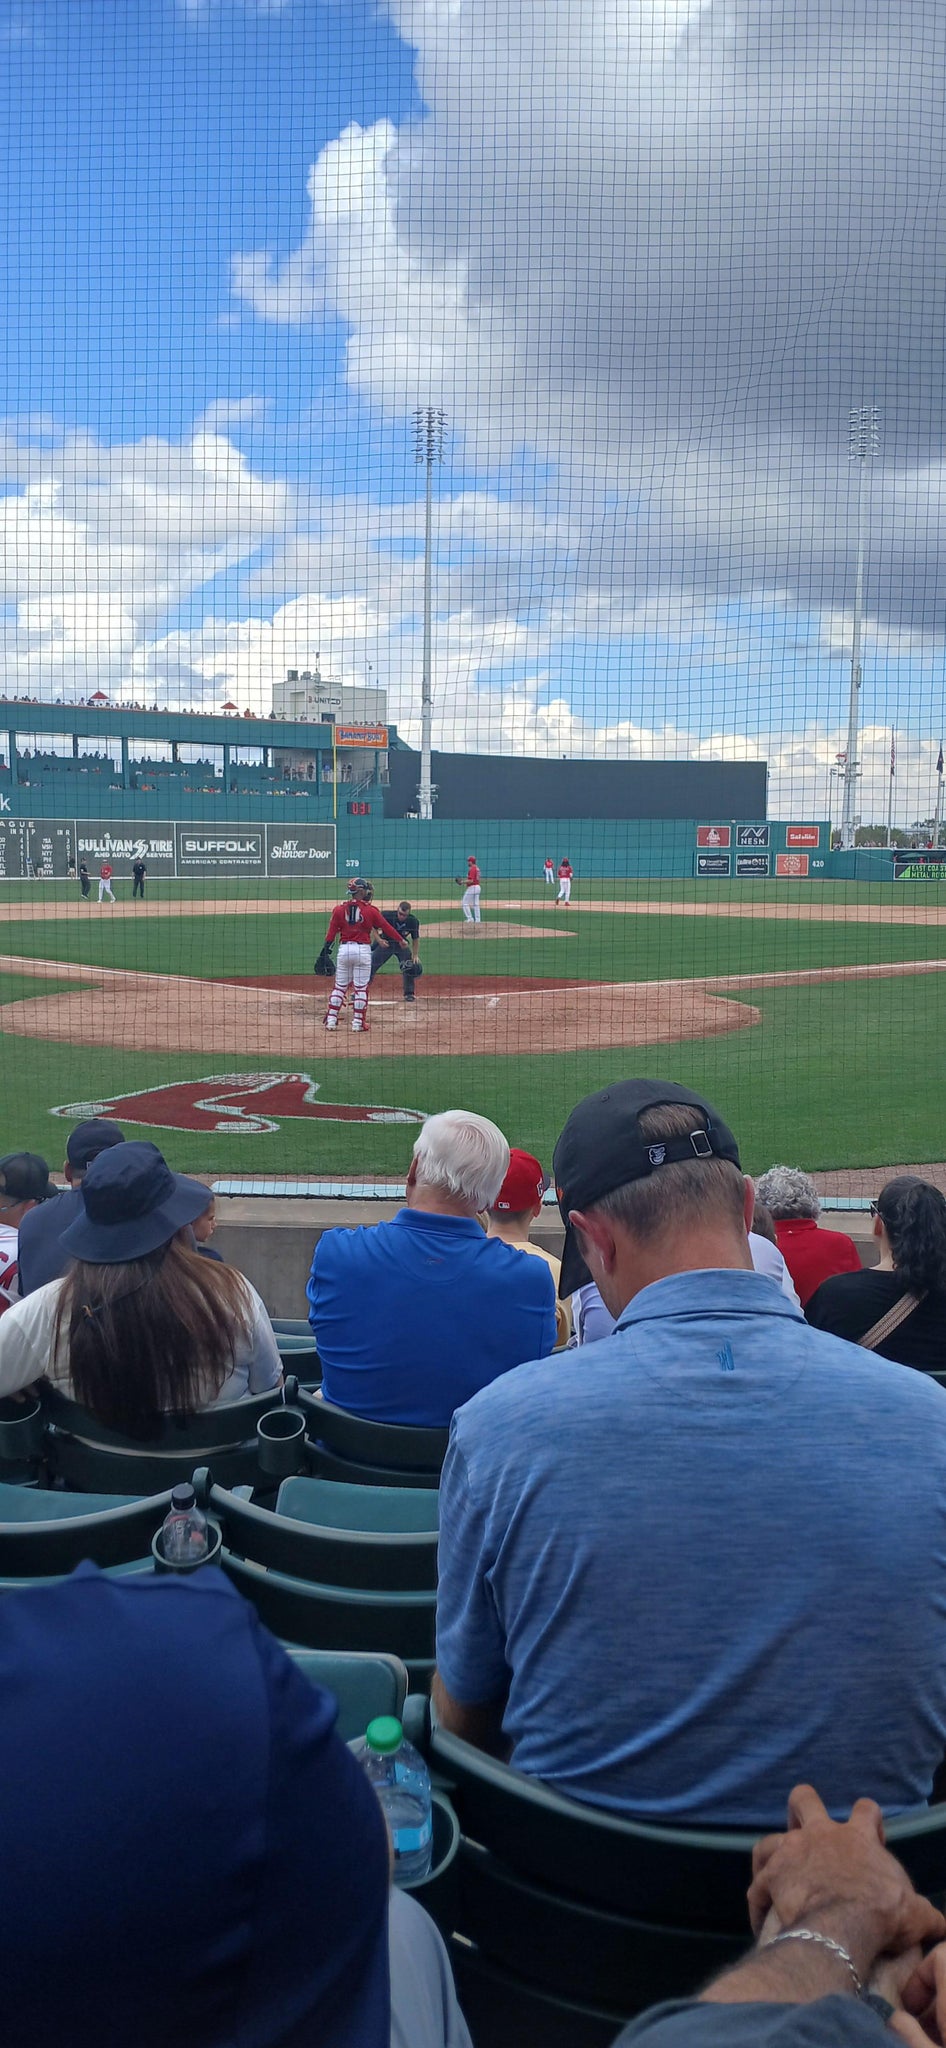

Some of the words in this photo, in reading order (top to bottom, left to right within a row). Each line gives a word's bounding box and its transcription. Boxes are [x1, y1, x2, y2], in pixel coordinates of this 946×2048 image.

[314, 697, 341, 705] UNITED
[740, 837, 765, 845] NESN
[78, 839, 133, 852] SULLIVAN
[149, 839, 173, 852] TIRE
[185, 840, 257, 852] SUFFOLK
[282, 840, 299, 851] MY
[111, 851, 131, 859] AUTO
[271, 846, 308, 859] Shower
[308, 848, 332, 859] Door
[345, 859, 360, 867] 379
[812, 860, 825, 868] 420
